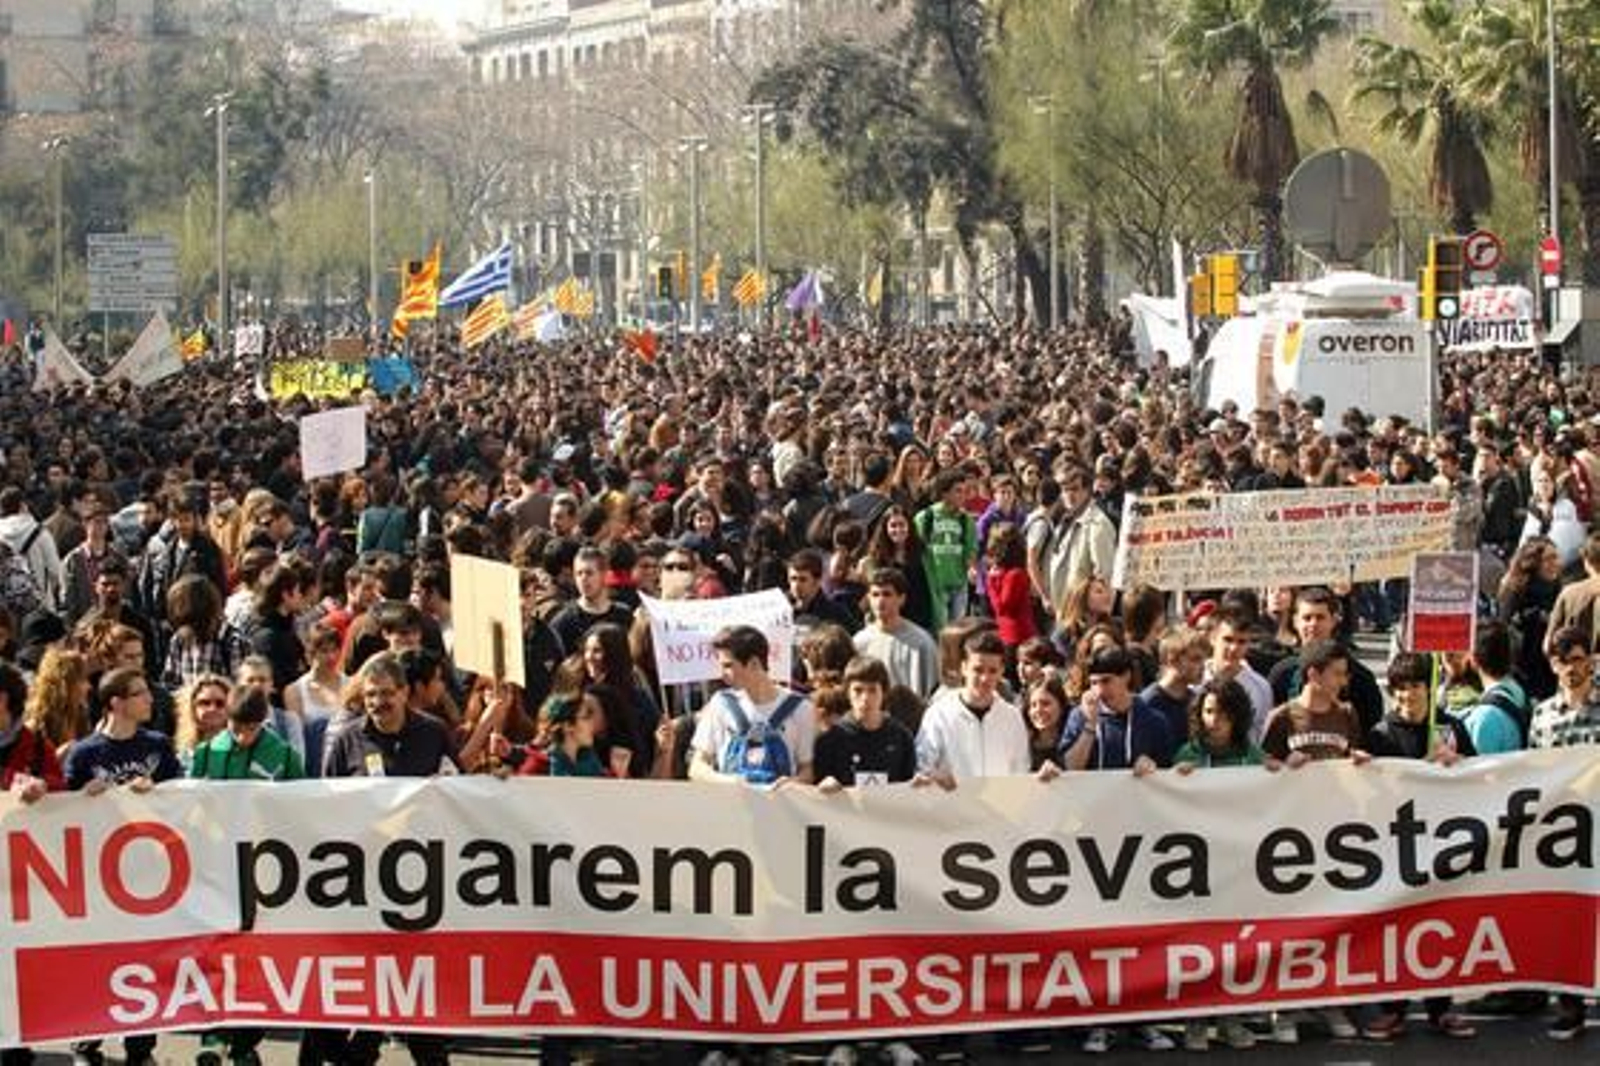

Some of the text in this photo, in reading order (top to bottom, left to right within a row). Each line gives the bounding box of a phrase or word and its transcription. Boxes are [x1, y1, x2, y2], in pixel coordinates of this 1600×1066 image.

[1318, 334, 1415, 353] overon
[668, 641, 694, 662] NO
[8, 788, 1594, 932] NO pagarem la seva estafa
[109, 917, 1513, 1024] SALVEM LA UNIVERSITAT PÚBLICA
